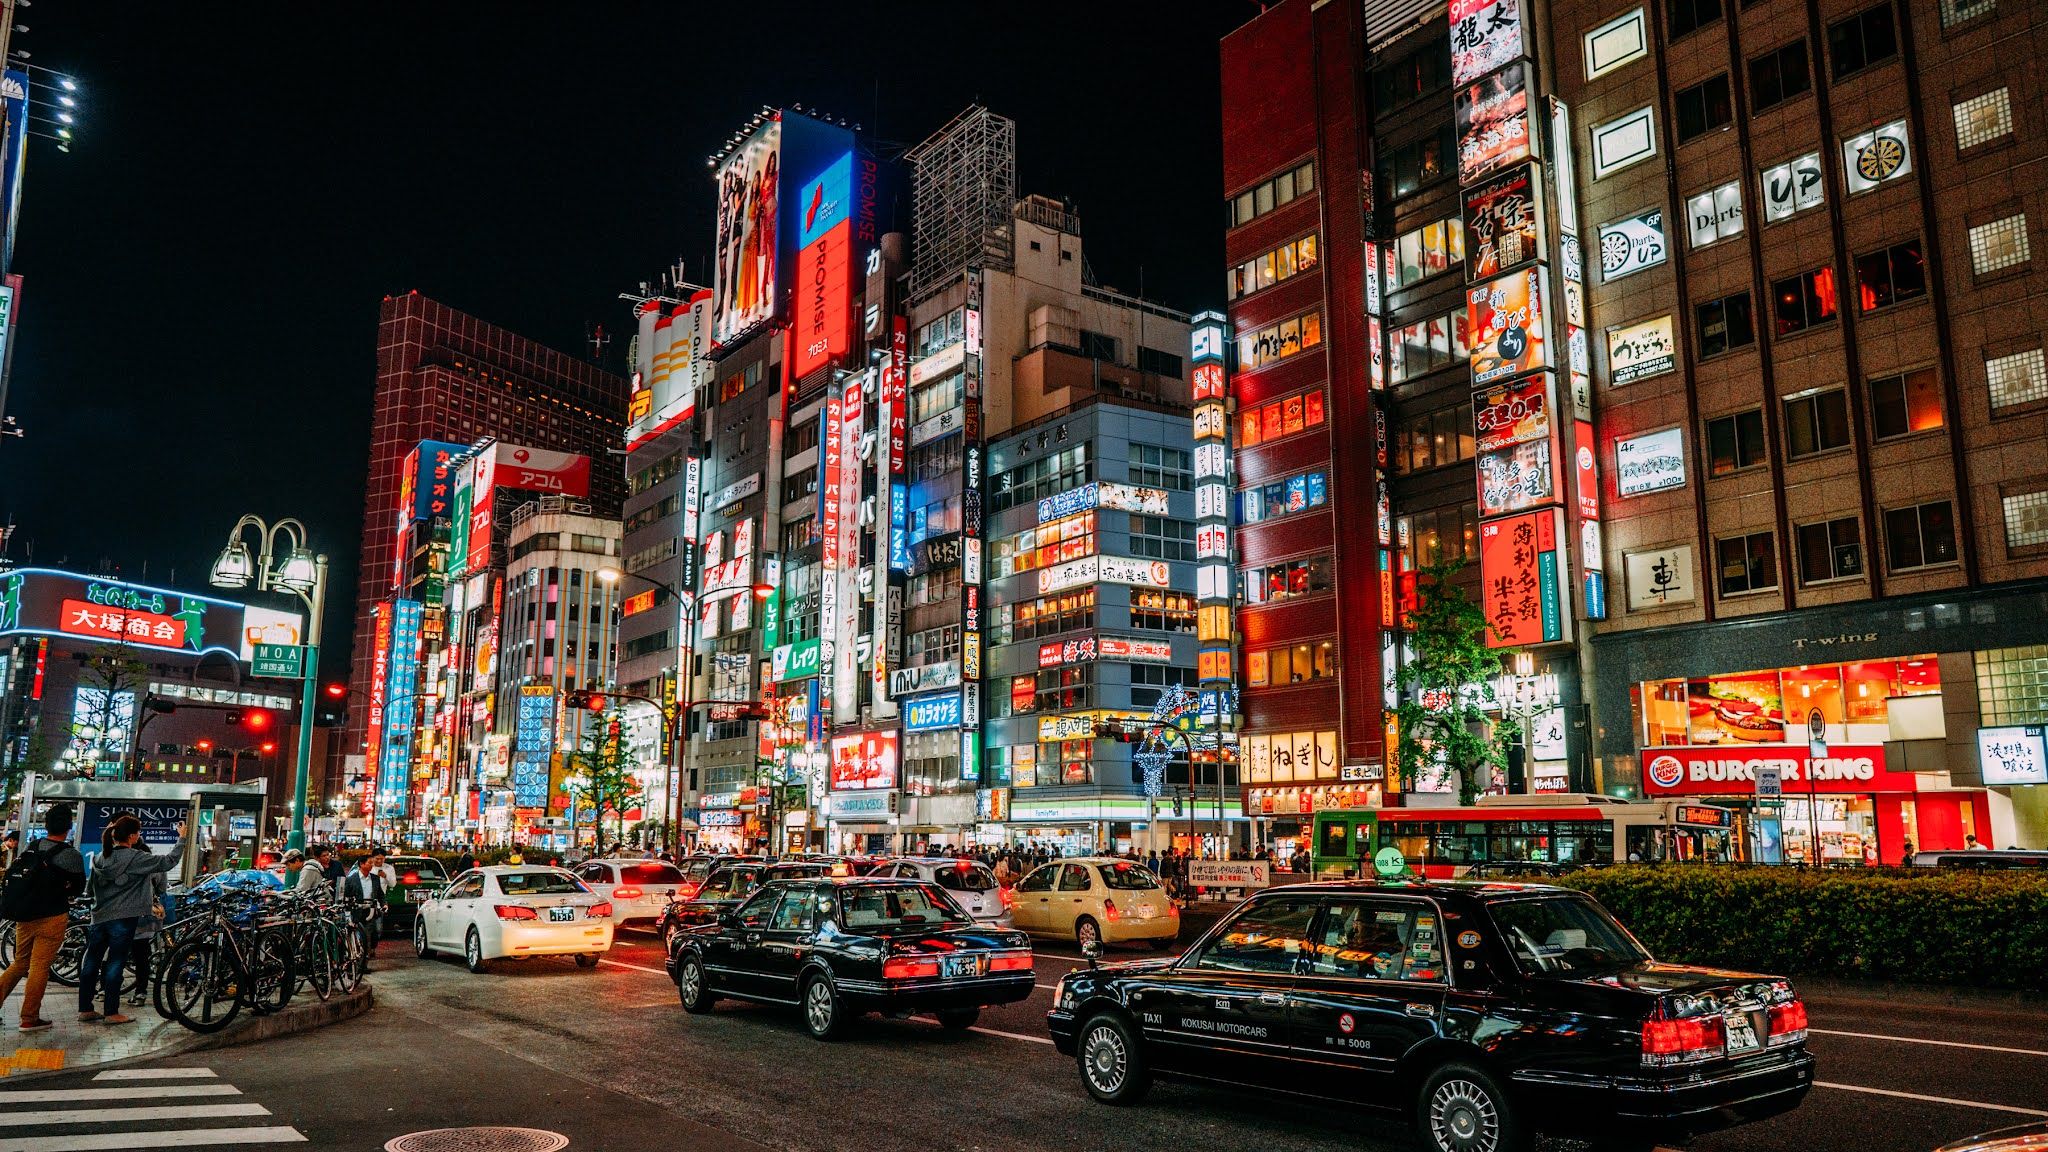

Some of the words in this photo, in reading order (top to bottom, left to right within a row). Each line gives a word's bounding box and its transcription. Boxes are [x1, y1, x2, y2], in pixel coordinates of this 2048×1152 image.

[1771, 166, 1823, 204] UP
[859, 159, 878, 243] PROMISE
[1646, 213, 1662, 227] 6F
[1696, 205, 1743, 231] Darts
[1632, 234, 1656, 248] Darts
[1638, 243, 1662, 263] UP
[812, 240, 826, 336] PROMISE
[693, 304, 703, 332] Don
[807, 337, 829, 360] プロミス
[1613, 338, 1668, 360] かまどか
[691, 336, 702, 388] Quijote
[892, 331, 906, 399] カラオケ
[826, 403, 841, 466] カラオケ
[891, 417, 905, 470] パセラ
[1017, 424, 1069, 457] 水野屋
[1620, 442, 1635, 452] 4F
[1479, 456, 1492, 469] 4F
[1493, 461, 1521, 482] 博多
[431, 450, 450, 514] カラオケ
[519, 471, 563, 490] アコム
[687, 463, 697, 506] 6年4組
[1484, 468, 1545, 502] ななつ星
[824, 484, 840, 531] パセラ
[454, 494, 463, 561] レイク
[473, 509, 490, 535] アコム
[893, 529, 903, 561] 747
[1649, 556, 1681, 600] 車
[87, 582, 167, 615] たのめーる
[821, 572, 835, 626] パーティー
[71, 608, 176, 641] 大塚商会
[766, 603, 777, 632] レイク
[887, 589, 901, 647] パーティー
[1063, 637, 1098, 663] 海峡
[1792, 631, 1879, 650] T-wing
[792, 646, 818, 670] レイク
[917, 701, 949, 725] カラオケ
[1055, 714, 1091, 737] 腹八分目
[2026, 728, 2041, 736] B1F
[1272, 742, 1334, 771] ねぎし
[1986, 742, 2033, 759] 淡路島と
[1343, 766, 1383, 779] 石塚ビル
[1655, 762, 1677, 773] BURGER
[1656, 769, 1679, 780] KING
[1804, 757, 1875, 781] KING
[2002, 758, 2039, 773] 喰らえ
[1761, 778, 1779, 786] タクシー
[1034, 809, 1059, 817] FamilyMart
[1215, 999, 1231, 1008] km
[1143, 1012, 1163, 1026] TAXI
[1181, 1017, 1216, 1032] KOKUSAI
[1216, 1021, 1268, 1038] MOTORCARS
[1347, 1038, 1371, 1049] 5008
